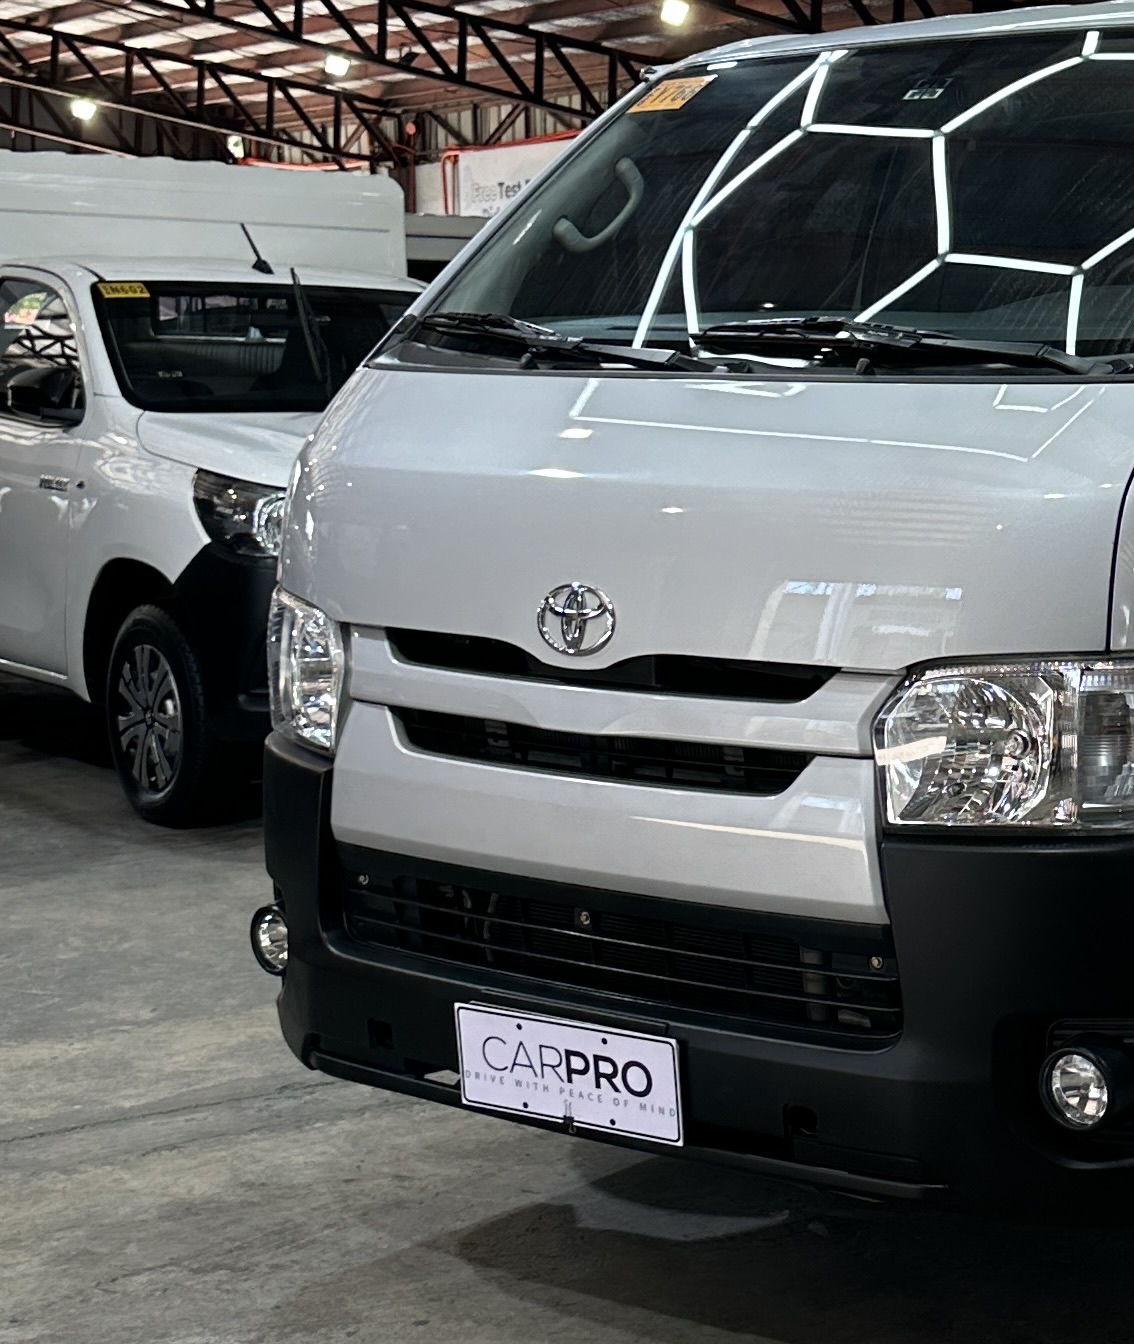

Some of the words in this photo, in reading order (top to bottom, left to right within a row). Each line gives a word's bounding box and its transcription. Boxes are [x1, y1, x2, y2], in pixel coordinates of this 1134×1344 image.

[465, 1069, 505, 1086] DRIVE
[514, 1078, 550, 1093] WITH
[559, 1086, 603, 1104] PEACE
[612, 1097, 630, 1109] OF
[639, 1102, 677, 1117] MIND
[482, 1036, 653, 1098] CARPRO
